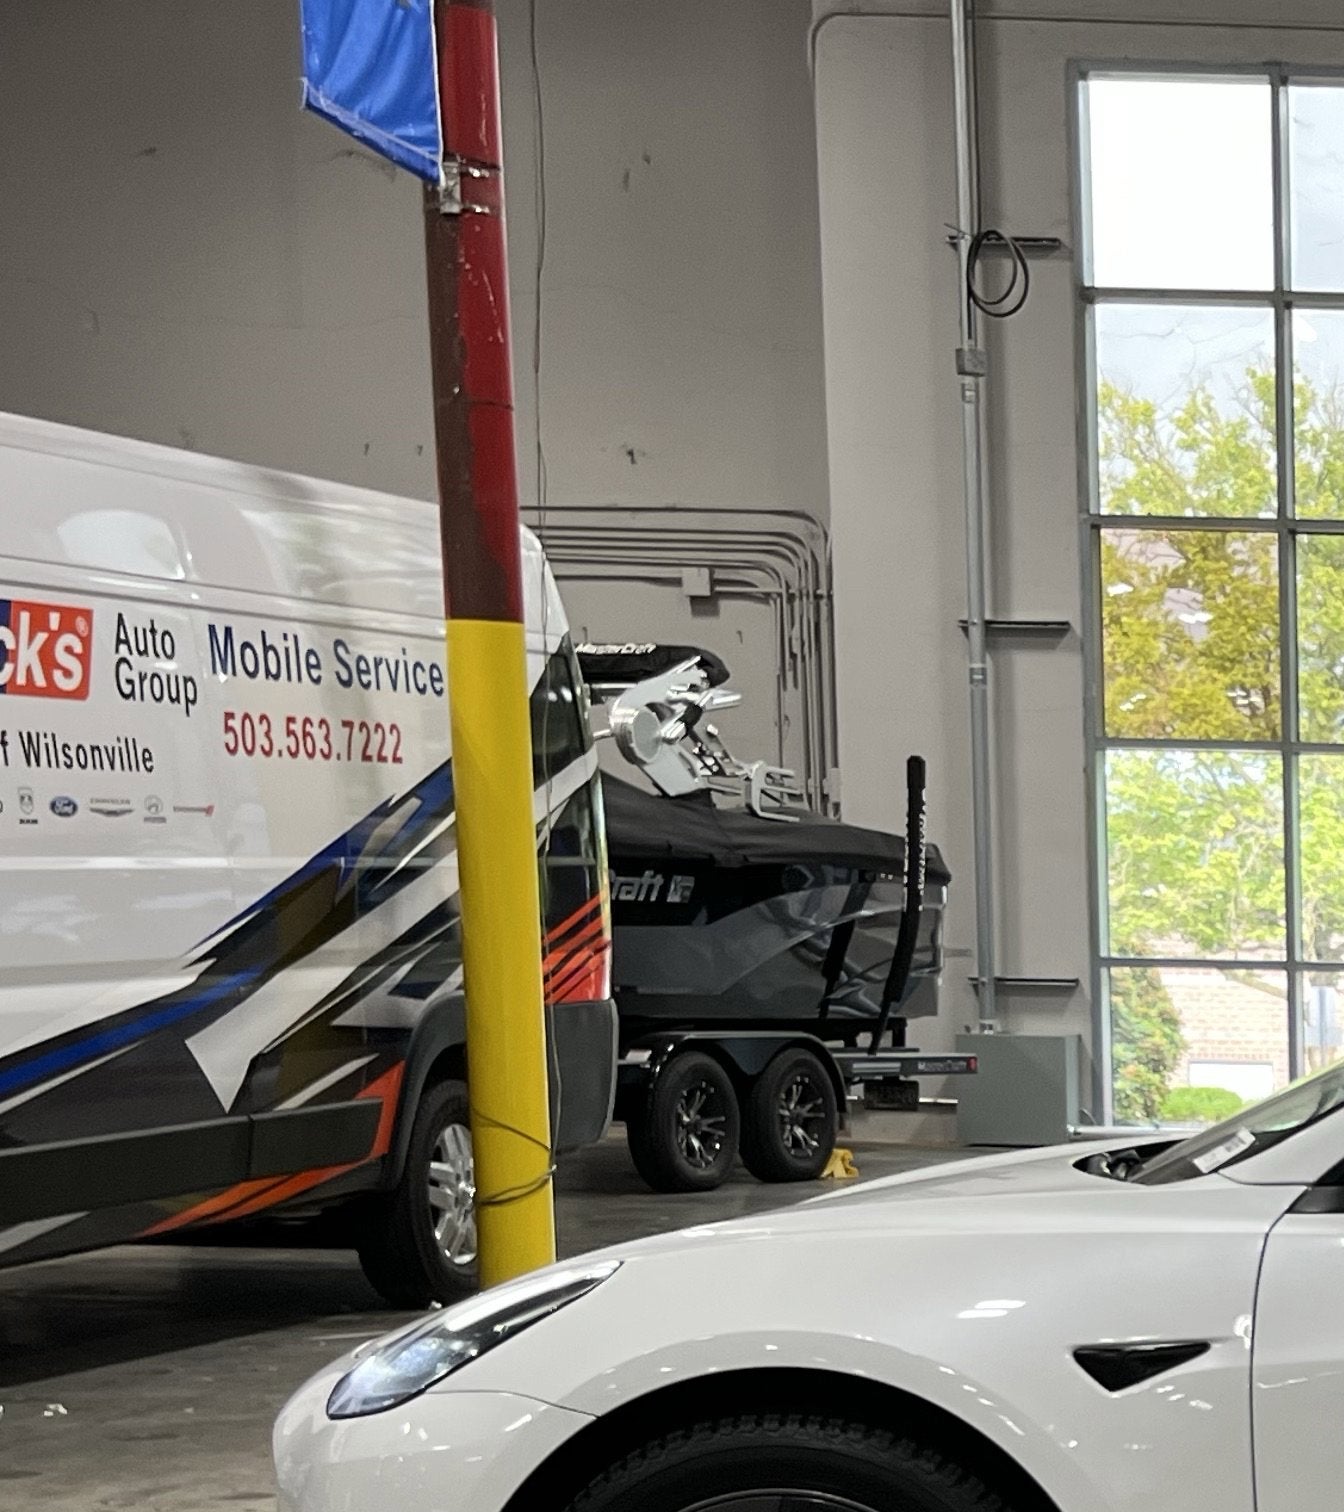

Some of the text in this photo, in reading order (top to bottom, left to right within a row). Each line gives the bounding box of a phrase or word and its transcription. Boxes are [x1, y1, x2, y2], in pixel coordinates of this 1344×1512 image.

[115, 613, 175, 659] Auto
[208, 624, 444, 697] Mobile Service
[115, 656, 198, 717] Group
[0, 730, 154, 773] f Wilsonville
[224, 711, 403, 764] 503.563.7222
